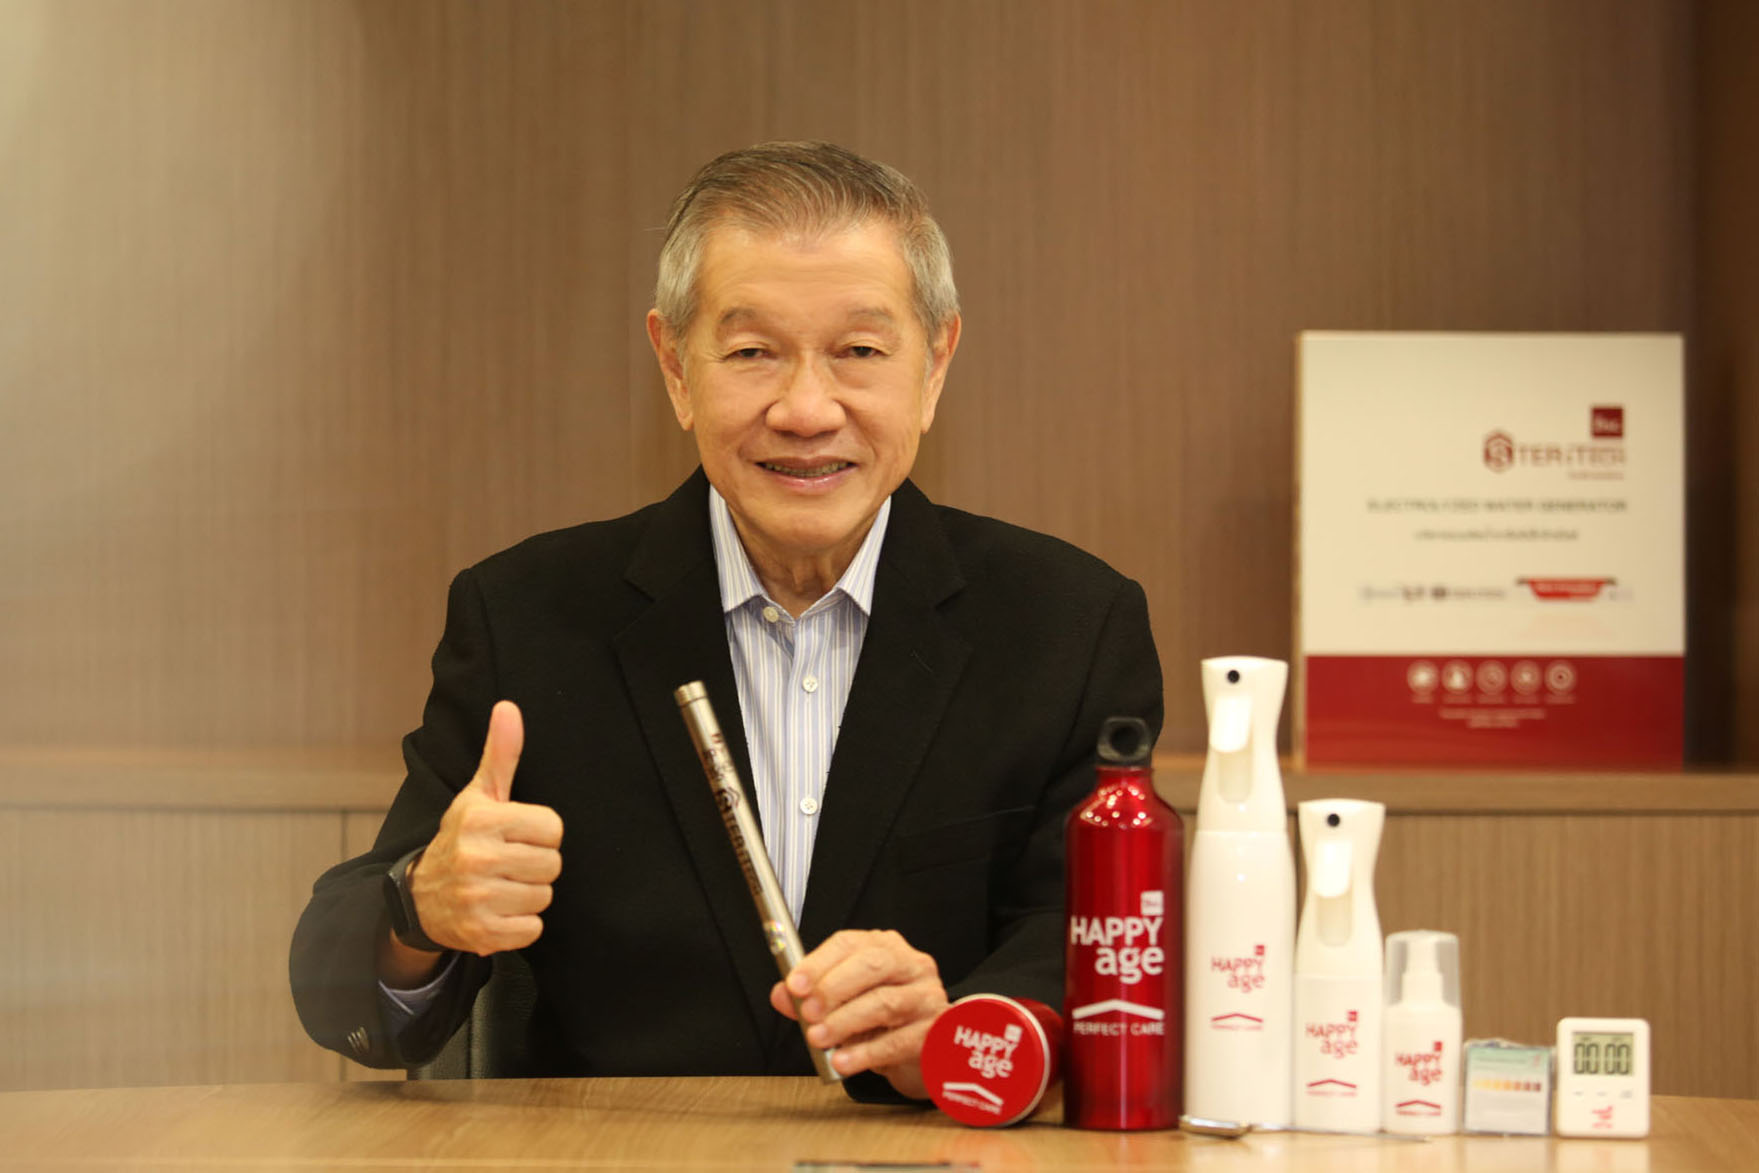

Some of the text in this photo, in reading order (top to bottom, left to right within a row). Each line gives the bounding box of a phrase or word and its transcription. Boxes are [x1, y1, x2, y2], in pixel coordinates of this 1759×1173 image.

[1070, 915, 1164, 946] HAPPY
[1094, 946, 1165, 984] age
[1210, 956, 1264, 975] HAPPY
[954, 1025, 1019, 1061] HAPPY
[1072, 1021, 1165, 1036] PERFECT CARE
[1305, 1022, 1357, 1041] HAPPY
[967, 1049, 1013, 1079] age
